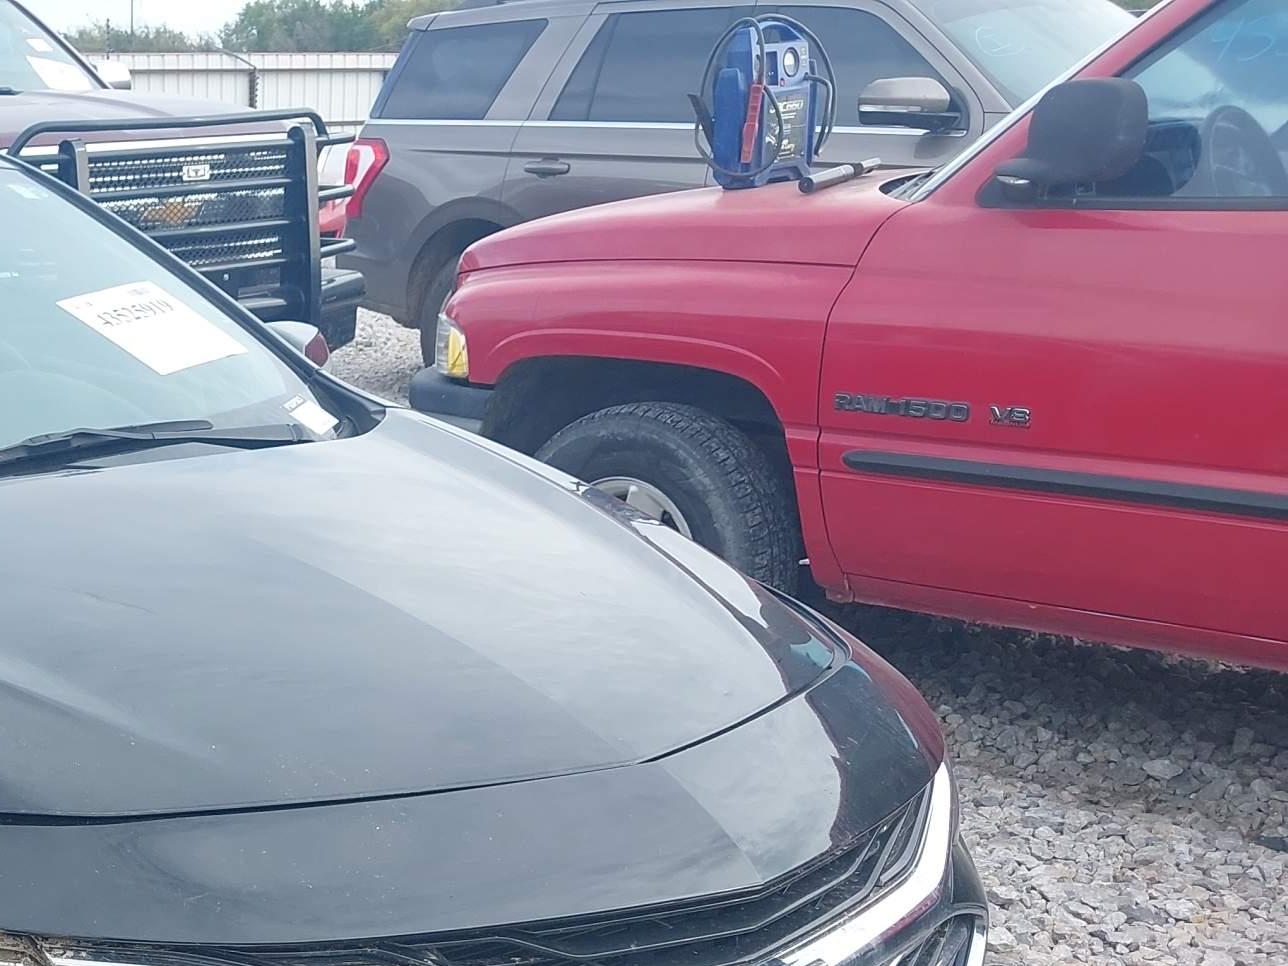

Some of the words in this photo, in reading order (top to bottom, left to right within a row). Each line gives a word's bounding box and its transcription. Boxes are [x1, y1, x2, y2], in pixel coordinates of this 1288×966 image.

[96, 298, 174, 327] 43525919
[834, 392, 889, 414] RAM
[897, 398, 970, 423] 1500
[990, 405, 1032, 423] V8
